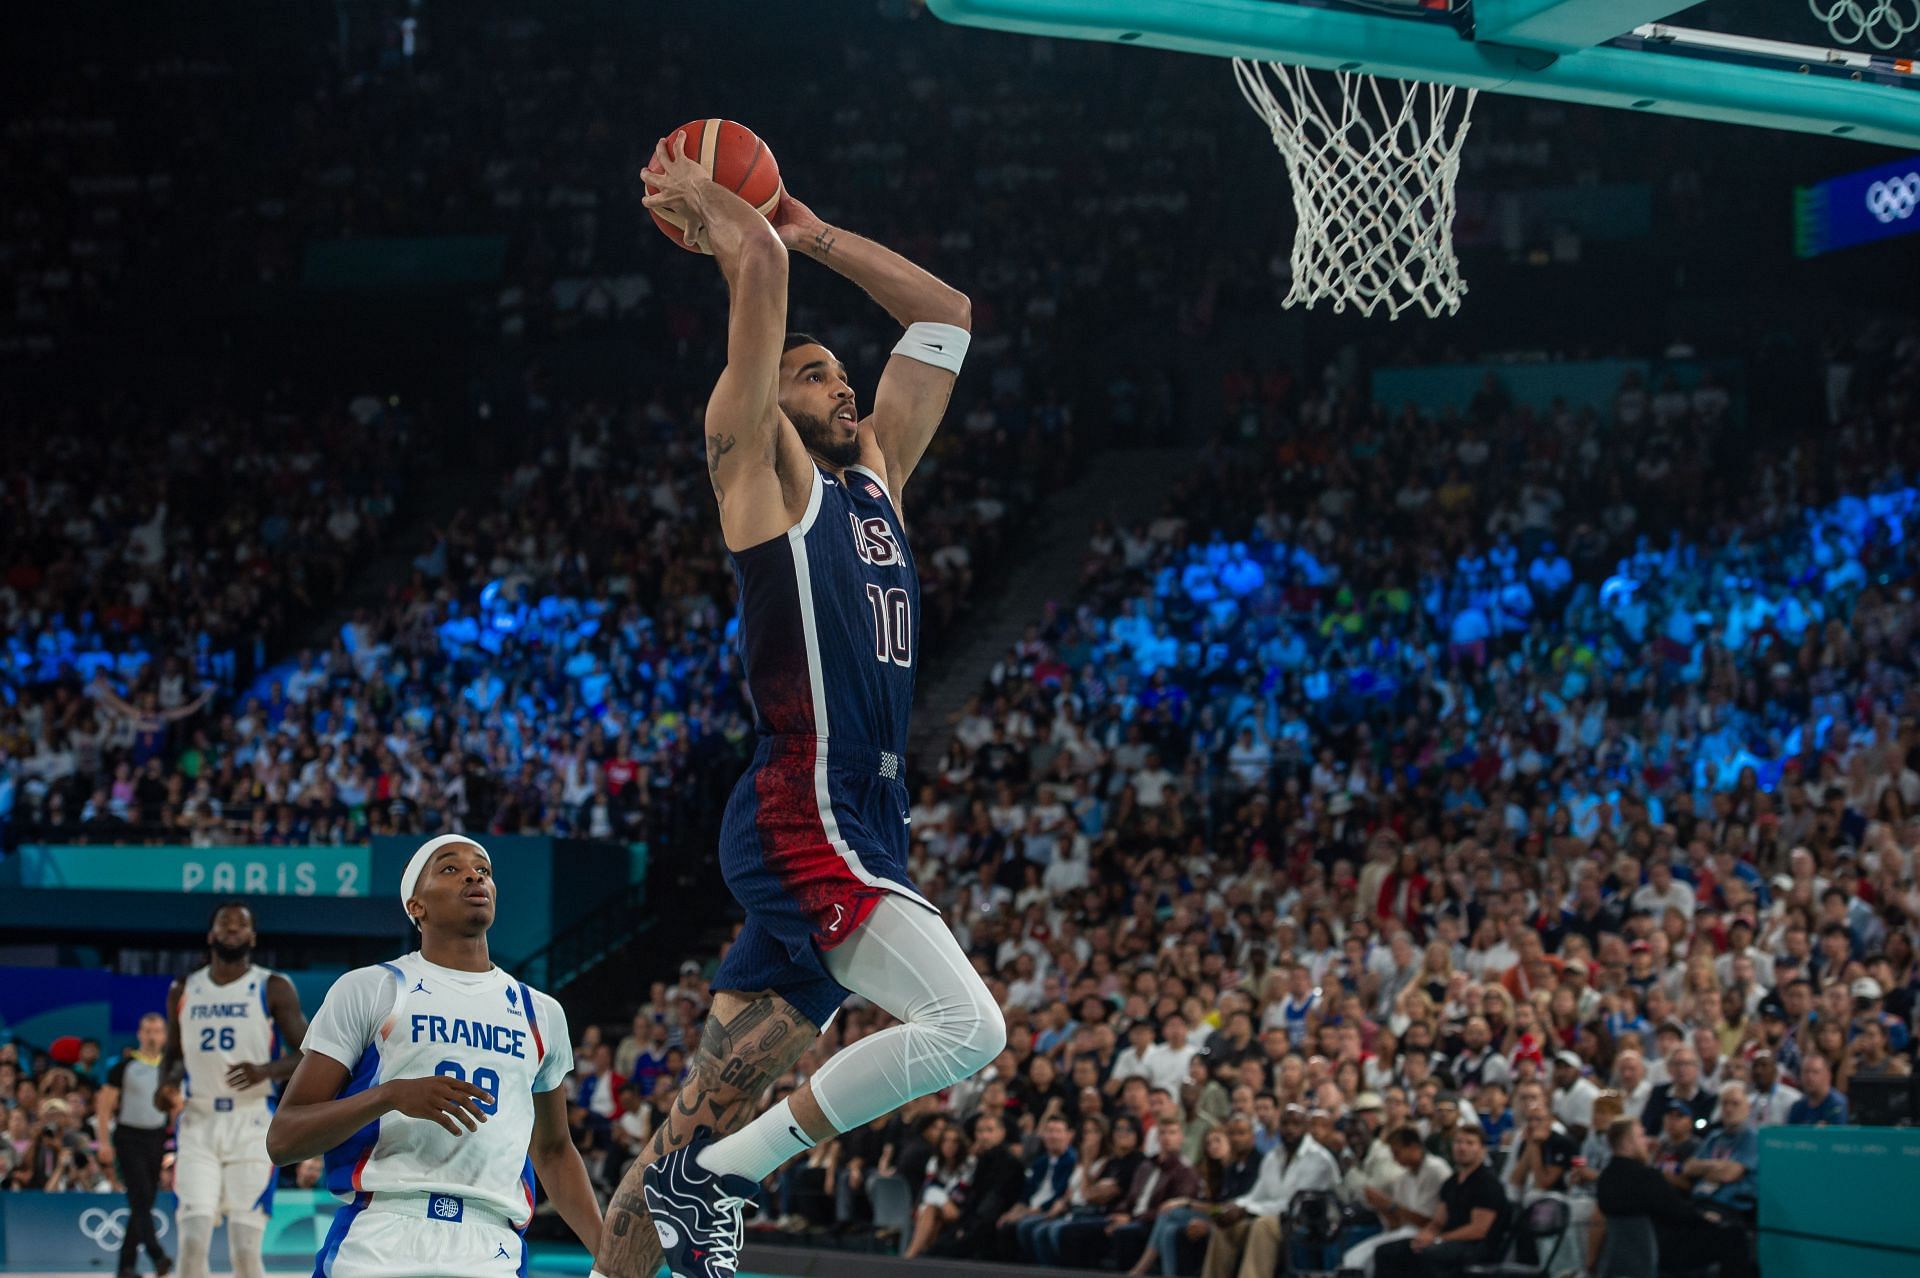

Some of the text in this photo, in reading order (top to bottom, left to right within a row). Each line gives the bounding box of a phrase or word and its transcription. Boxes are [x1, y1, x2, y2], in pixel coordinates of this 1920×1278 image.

[866, 583, 912, 668] 10
[182, 862, 317, 896] PARIS
[190, 1003, 249, 1020] FRANCE
[200, 1027, 236, 1052] 26
[411, 1014, 527, 1060] FRANCE
